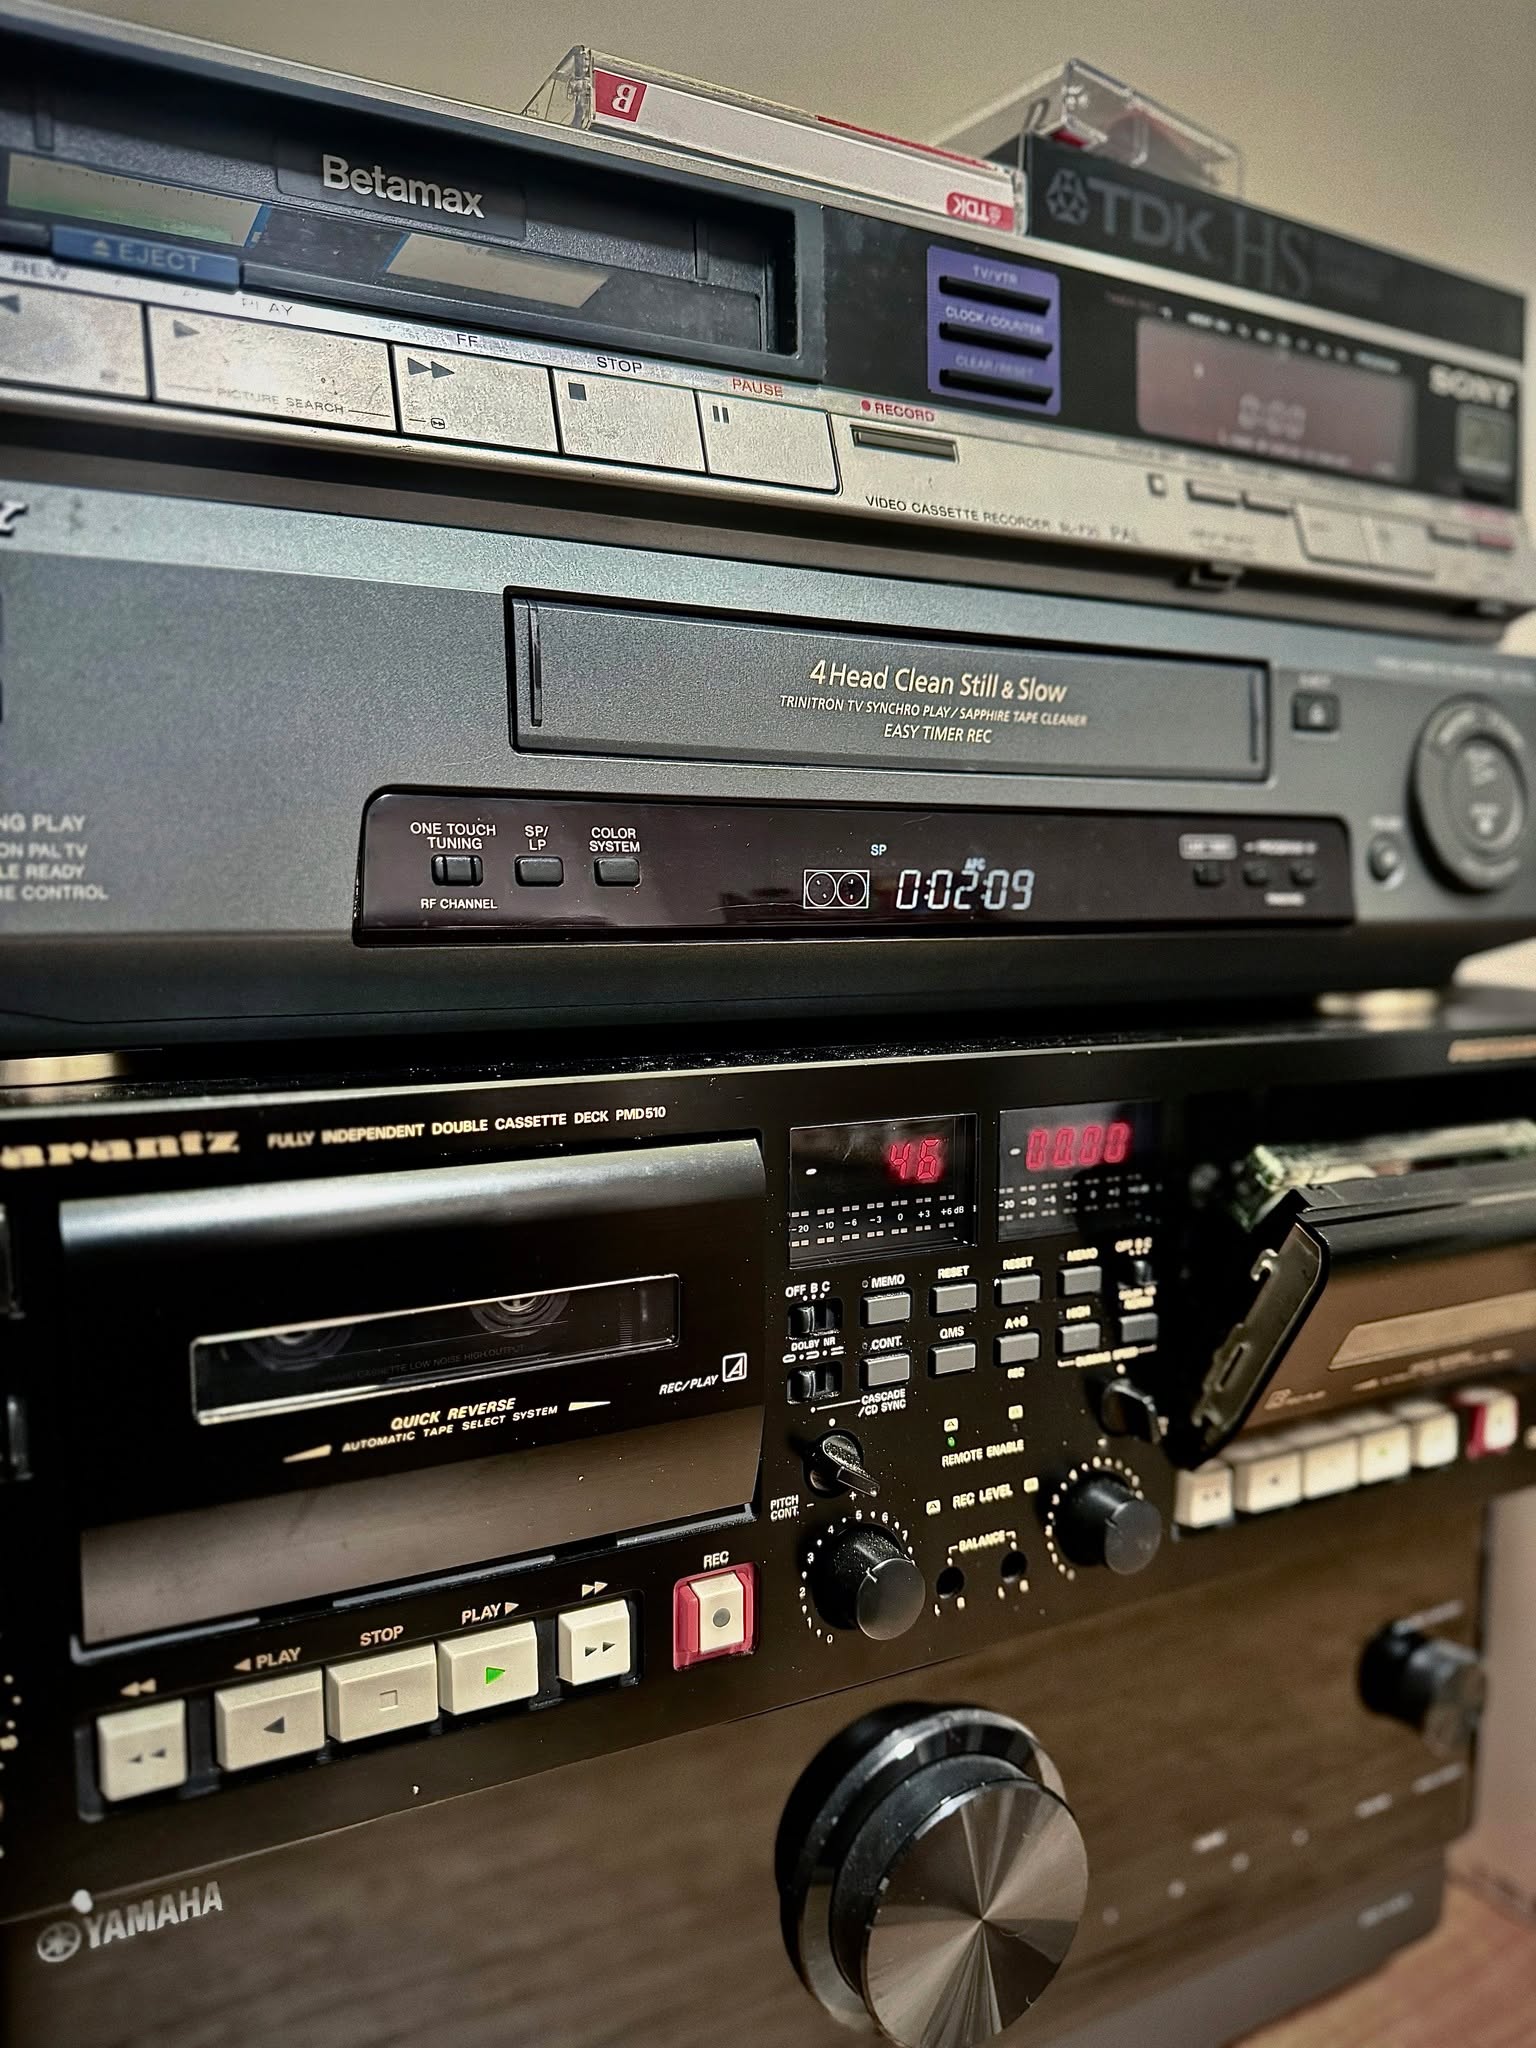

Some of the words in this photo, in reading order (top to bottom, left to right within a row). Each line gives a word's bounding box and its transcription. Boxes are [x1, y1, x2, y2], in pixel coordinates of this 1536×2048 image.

[612, 83, 637, 113] B
[322, 154, 485, 219] Betamax
[952, 196, 991, 222] TDK
[1086, 177, 1215, 261] TDK
[119, 241, 200, 273] EJECT
[12, 260, 69, 280] REW
[973, 265, 1018, 284] TV/VTR
[457, 333, 478, 347] FF
[597, 356, 642, 374] STOP
[732, 378, 783, 398] PAUSE
[218, 387, 279, 405] PICTURE
[286, 397, 344, 414] SEARCH
[875, 401, 935, 423] RECORD
[866, 496, 907, 512] VIDEO
[912, 502, 979, 522] CASSETTE
[983, 511, 1050, 531] RECORDER
[895, 667, 953, 695] Clean
[960, 673, 997, 698] Still
[1001, 681, 1013, 699] &
[1018, 677, 1068, 703] Slow
[780, 695, 844, 712] TRINITRON
[847, 699, 864, 713] TV
[866, 700, 920, 717] SYNCHRO
[1013, 711, 1038, 725] TAPE
[884, 723, 919, 739] EASY
[923, 725, 963, 742] TIMER
[967, 728, 992, 743] REC
[32, 814, 85, 832] PLAY
[410, 822, 442, 836] ONE
[448, 823, 496, 836] TOUCH
[524, 825, 549, 838] SP/
[427, 836, 483, 850] TUNING
[591, 827, 637, 840] COLOR
[28, 843, 62, 860] PAL
[64, 843, 88, 859] TV
[529, 839, 547, 851] LP
[589, 840, 641, 853] SYSTEM
[871, 844, 887, 856] SP
[26, 863, 86, 880] READY
[21, 884, 109, 901] CONTROL
[896, 869, 1035, 910] 0:02:09
[420, 899, 437, 909] RF
[440, 898, 498, 909] CHANNEL
[268, 1130, 316, 1149] FULLY
[322, 1123, 425, 1145] INDEPENDENT
[432, 1118, 489, 1135] DOUBLE
[495, 1112, 567, 1131] CASSETTE
[574, 1108, 610, 1125] DECK
[889, 1138, 940, 1181] 46
[897, 1213, 904, 1221] 0
[872, 1274, 905, 1289] MEMO
[938, 1265, 970, 1279] RESET
[785, 1284, 806, 1298] OFF
[810, 1282, 818, 1293] B
[822, 1281, 830, 1292] C
[940, 1326, 964, 1339] QMS
[791, 1341, 819, 1351] DOLBY
[824, 1336, 836, 1347] NR
[410, 1360, 431, 1371] LOW
[434, 1355, 461, 1367] NOISE
[464, 1351, 485, 1361] HIGH
[659, 1374, 719, 1395] REC/PLAY
[861, 1388, 906, 1405] CASCADE
[391, 1410, 440, 1430] QUICK
[447, 1397, 516, 1421] REVERSE
[858, 1404, 878, 1417] /CD
[881, 1399, 906, 1412] SYNC
[342, 1431, 416, 1452] AUTOMATIC
[423, 1424, 453, 1437] TAPE
[462, 1415, 506, 1431] SELECT
[512, 1405, 558, 1422] SYSTEM
[942, 1448, 983, 1467] REMOTE
[986, 1439, 1024, 1458] ENABLE
[770, 1494, 799, 1510] PITCH
[953, 1492, 975, 1509] REC
[979, 1483, 1013, 1503] LEVEL
[959, 1530, 1005, 1553] BALANCE
[703, 1551, 730, 1568] REC
[799, 1587, 806, 1598] 2
[807, 1552, 814, 1563] 3
[827, 1525, 834, 1534] 4
[855, 1510, 862, 1520] 5
[882, 1512, 889, 1523] 6
[902, 1530, 908, 1541] 7
[462, 1602, 501, 1625] PLAY
[360, 1625, 404, 1646] STOP
[256, 1647, 301, 1670] PLAY
[85, 1881, 223, 1949] YAMAHA
